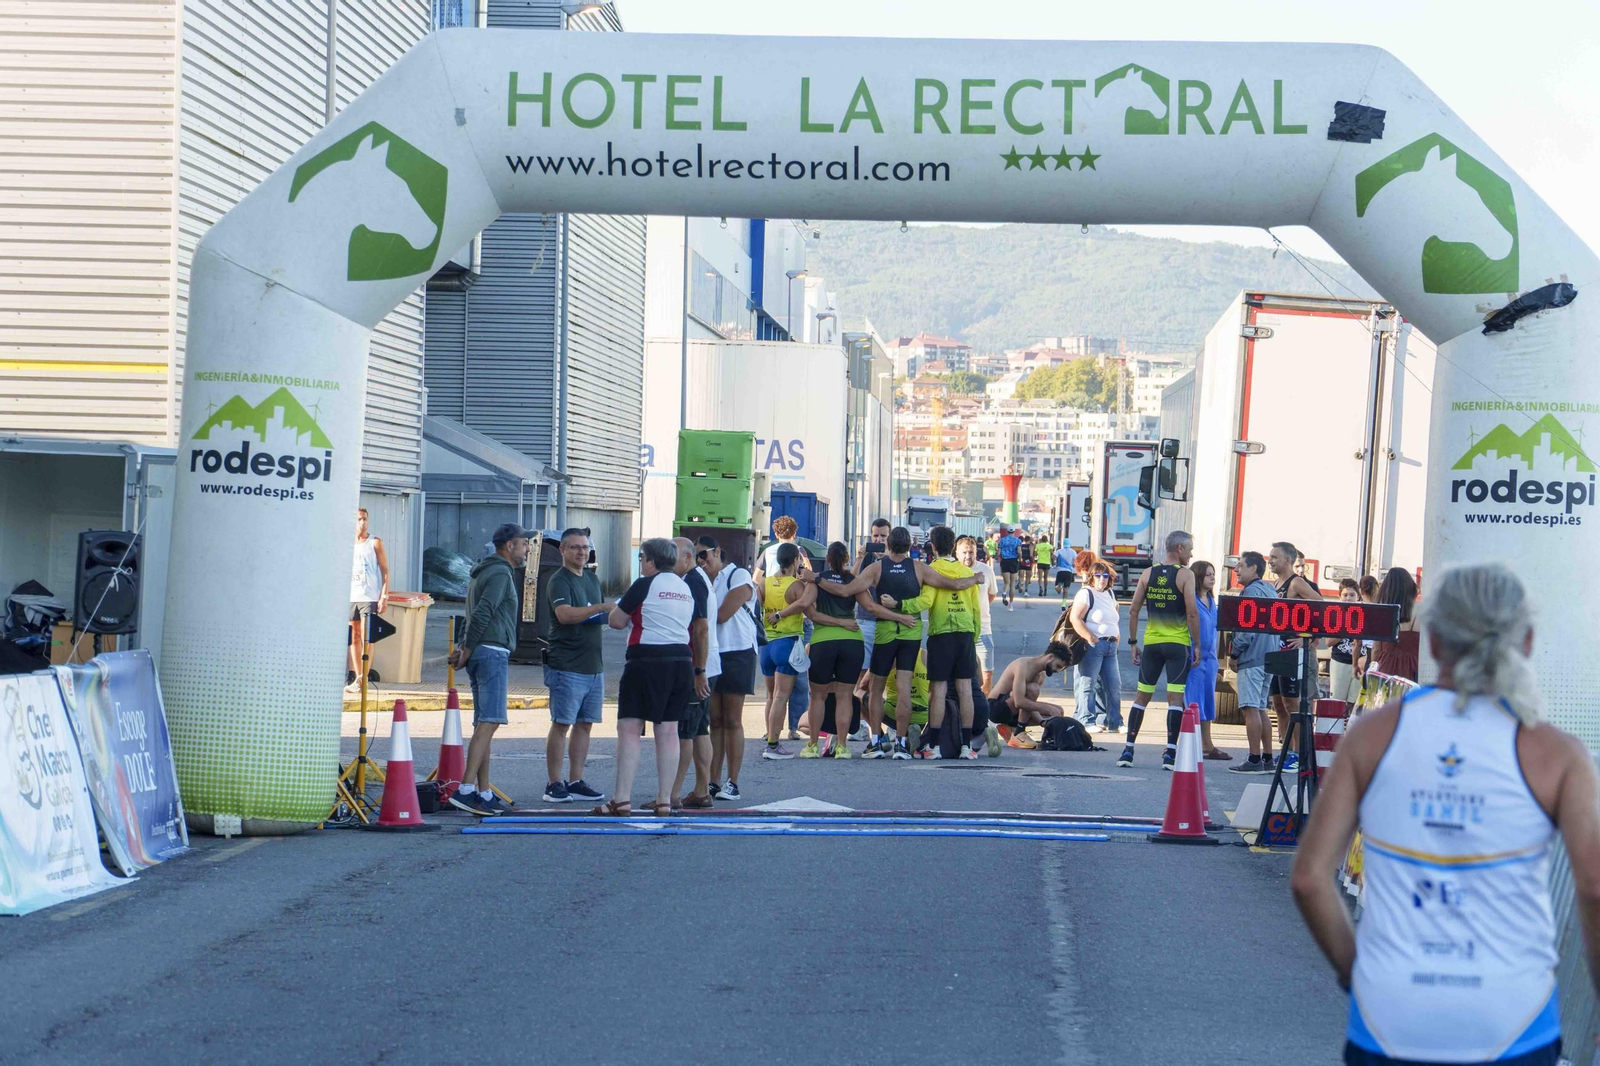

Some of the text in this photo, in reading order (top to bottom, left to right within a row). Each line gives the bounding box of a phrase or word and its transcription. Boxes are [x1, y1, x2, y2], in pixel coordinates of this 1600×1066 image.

[507, 64, 1308, 135] HOTEL LA RECTRAL
[505, 141, 951, 182] www.hotelrectoral.com
[190, 440, 332, 489] rodespi
[200, 483, 314, 501] www.rodespi.es
[1451, 469, 1596, 514] rodespi
[1464, 511, 1582, 528] www.rodespi.es
[1237, 599, 1365, 635] 0:00:00
[115, 701, 148, 751] Escoge
[124, 751, 157, 794] DOLE
